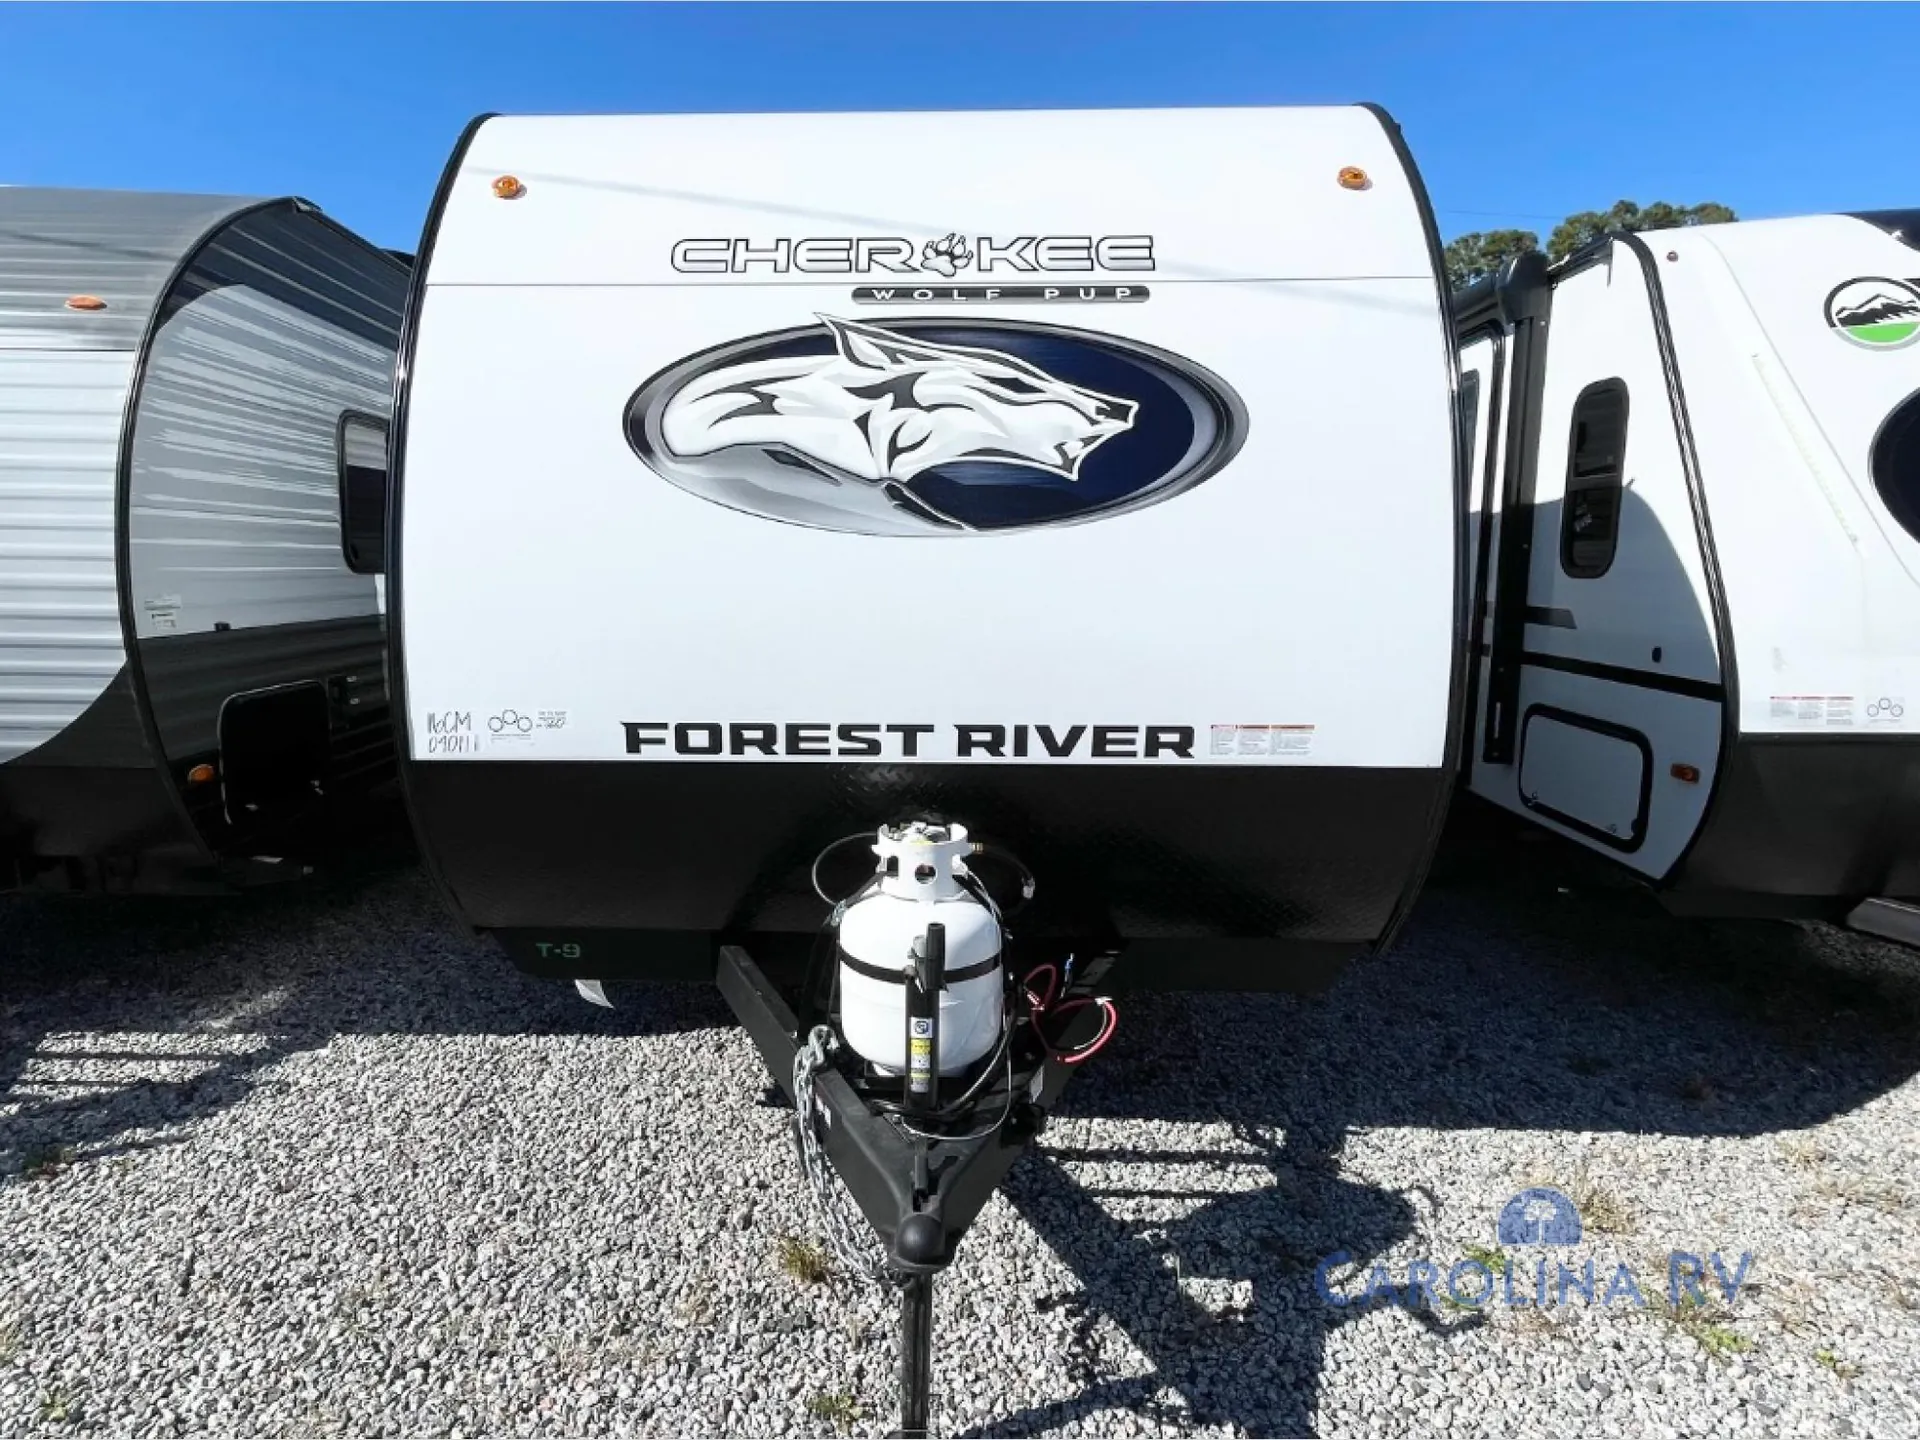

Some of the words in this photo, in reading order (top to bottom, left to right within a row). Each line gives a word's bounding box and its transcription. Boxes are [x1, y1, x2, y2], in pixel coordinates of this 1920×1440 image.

[671, 233, 1155, 276] CHEROKEE
[871, 288, 1002, 301] WOLF
[1043, 287, 1132, 301] PUP
[620, 721, 935, 757] FOREST
[953, 724, 1196, 759] RIVER
[535, 943, 581, 958] T-9
